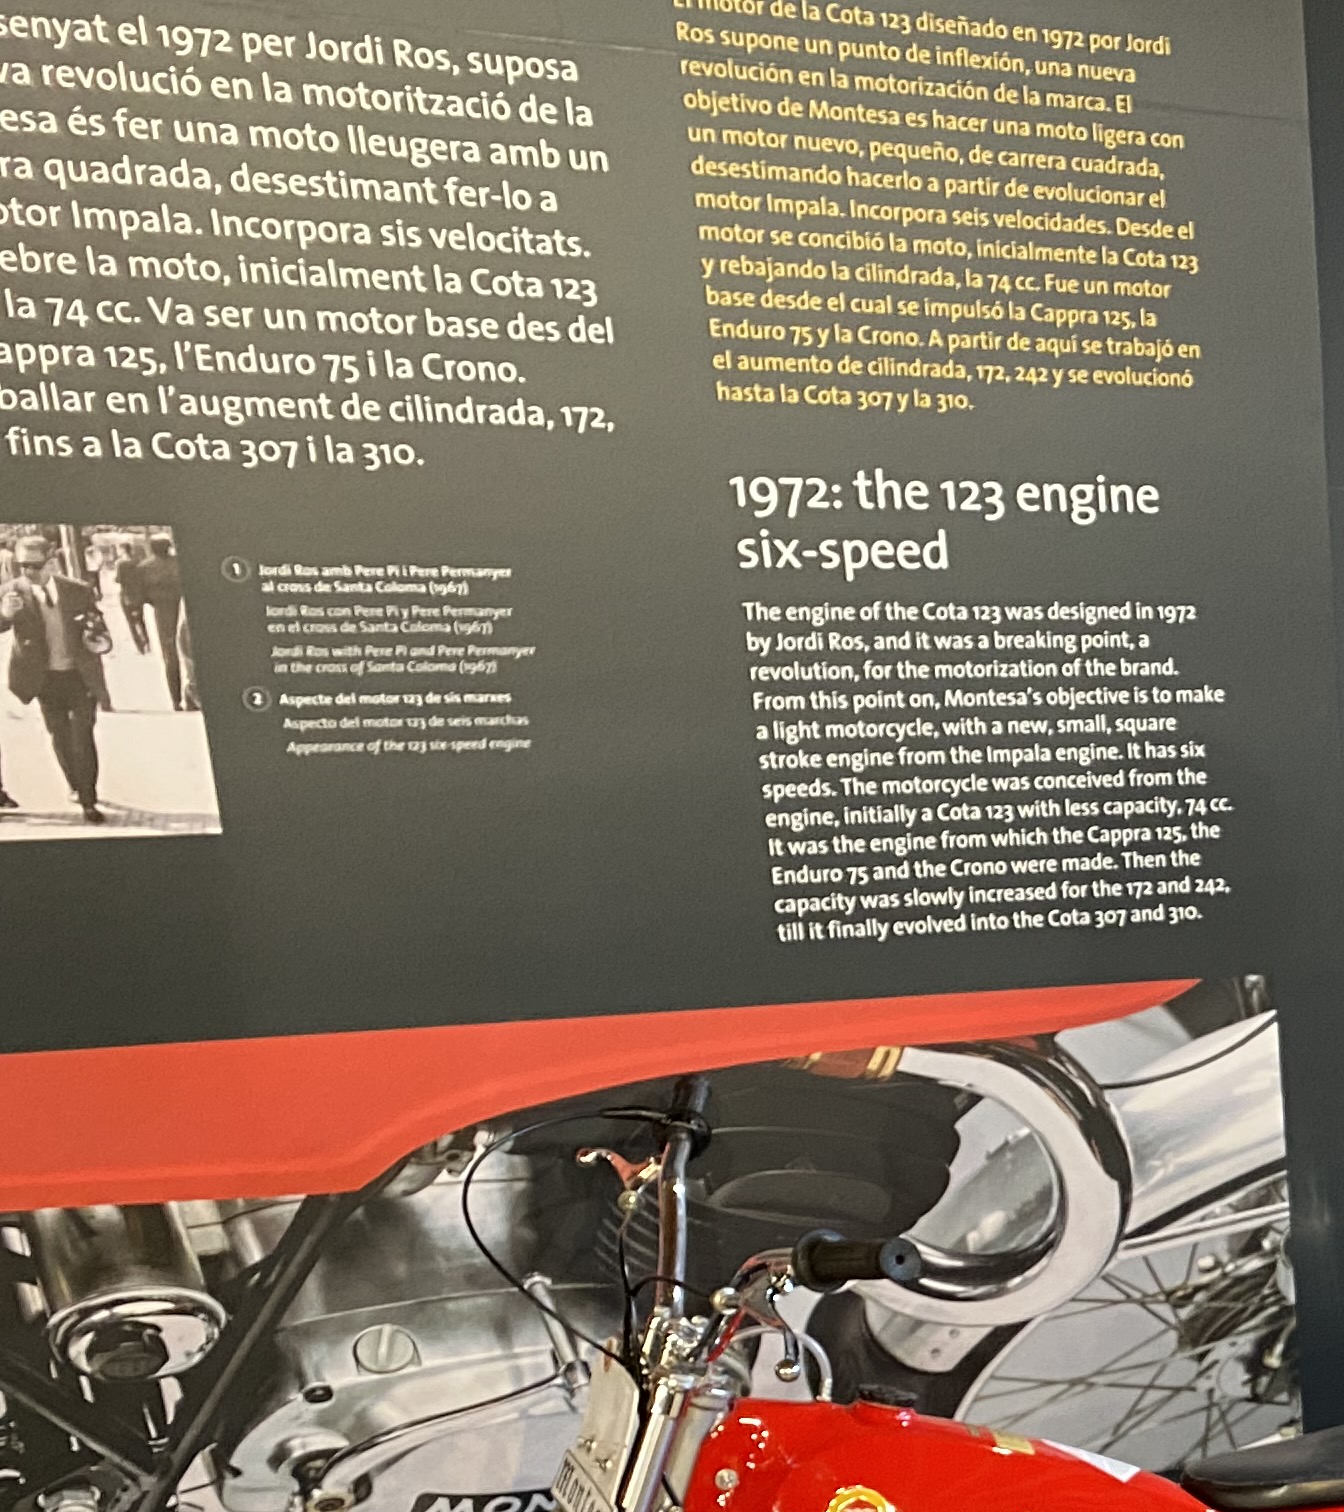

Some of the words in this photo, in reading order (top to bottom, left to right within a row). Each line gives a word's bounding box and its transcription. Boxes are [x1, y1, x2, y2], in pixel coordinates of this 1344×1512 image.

[117, 14, 149, 46] el
[155, 23, 234, 58] 1972
[241, 31, 297, 64] per
[305, 30, 386, 66] Jordi
[392, 37, 461, 77] Ros,
[466, 51, 579, 86] suposa
[676, 20, 716, 45] Ros
[719, 28, 800, 55] supone
[804, 37, 834, 56] un
[837, 40, 902, 63] punto
[905, 42, 931, 66] de
[935, 44, 1031, 77] inflexión,
[1034, 59, 1073, 78] una
[1077, 63, 1136, 84] nueva
[41, 60, 202, 97] revolució
[210, 75, 254, 101] en
[261, 70, 294, 104] la
[302, 85, 513, 121] motorització
[518, 92, 559, 125] de
[564, 95, 594, 128] la
[0, 108, 59, 135] esa
[67, 104, 106, 138] és
[111, 107, 163, 141] fer
[173, 119, 240, 147] una
[248, 122, 341, 154] moto
[347, 123, 482, 169] lleugera
[489, 138, 561, 169] amb
[568, 148, 610, 173] un
[4, 425, 74, 458] fins
[82, 435, 103, 458] a
[111, 427, 144, 459] la
[151, 430, 232, 462] Cota
[239, 438, 299, 469] 307
[305, 434, 318, 463] i
[324, 433, 355, 464] la
[361, 441, 425, 472] 310.
[728, 475, 844, 520] 1972:
[851, 467, 930, 511] the
[939, 480, 1006, 521] 123
[1016, 473, 1160, 526] engine
[737, 528, 949, 583] six-speed
[741, 601, 782, 622] The
[785, 601, 856, 628] engine
[859, 600, 882, 622] of
[884, 600, 920, 621] the
[922, 601, 969, 621] Cota
[971, 605, 1002, 625] 123
[1004, 605, 1045, 621] was
[1047, 600, 1132, 626] designed
[1135, 601, 1154, 620] in
[1156, 605, 1197, 624] 1972
